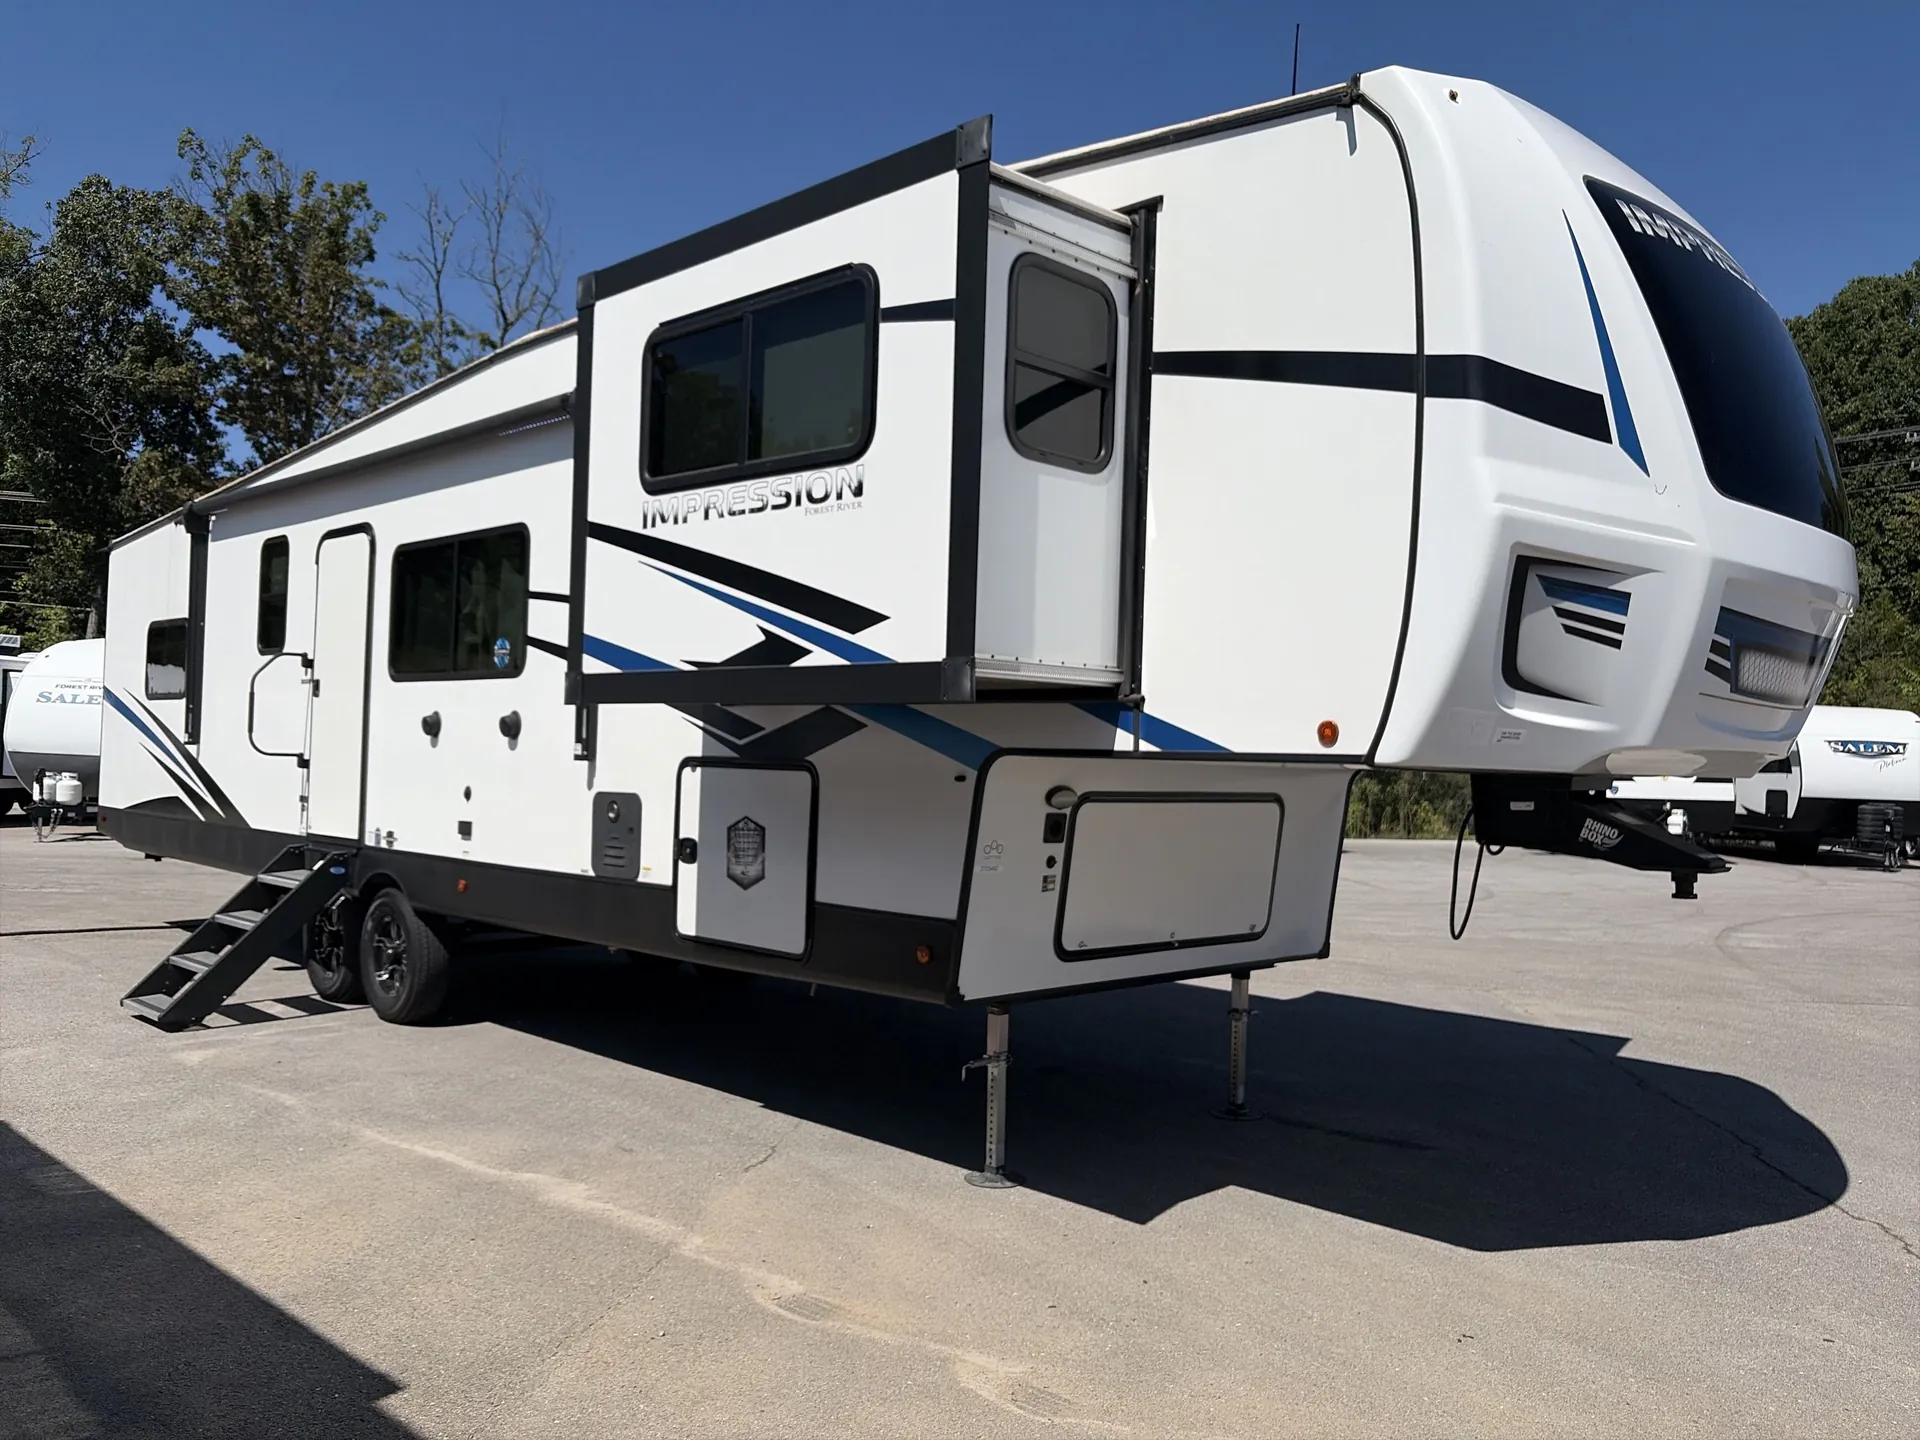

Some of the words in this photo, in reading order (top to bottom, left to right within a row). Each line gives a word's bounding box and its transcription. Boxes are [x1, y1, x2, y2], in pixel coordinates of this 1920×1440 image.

[641, 464, 865, 530] IMPRESSION
[36, 691, 102, 705] SALE
[1829, 740, 1905, 754] SALEM
[1580, 827, 1604, 845] BOX
[1584, 817, 1619, 839] RHINO
